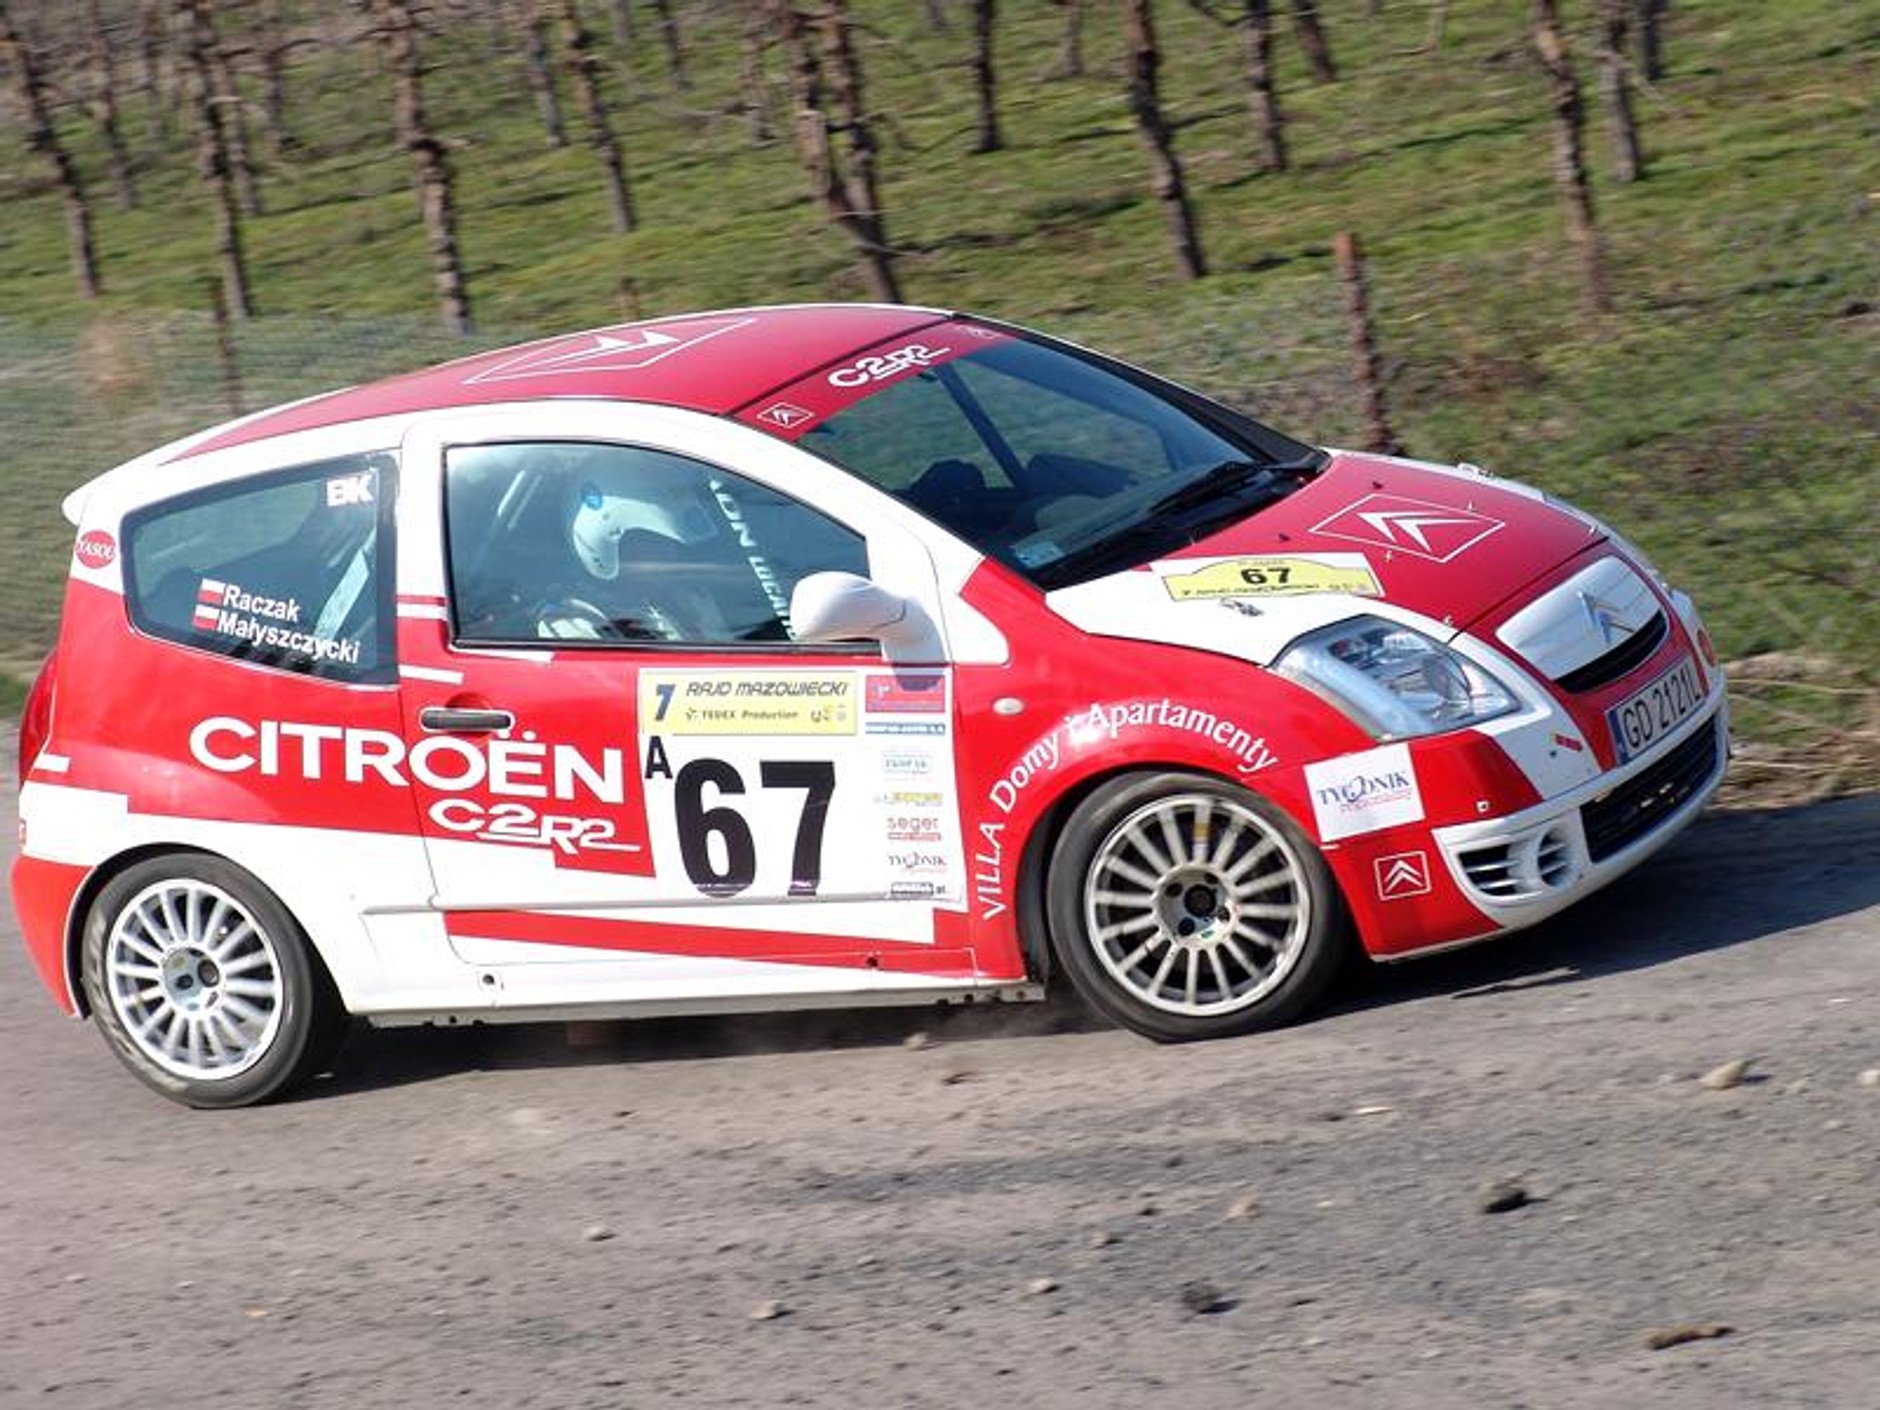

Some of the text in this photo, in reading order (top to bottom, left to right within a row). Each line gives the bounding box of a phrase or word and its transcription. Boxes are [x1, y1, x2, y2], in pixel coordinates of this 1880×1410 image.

[827, 344, 951, 388] C2R2
[1240, 567, 1291, 585] 67
[223, 584, 301, 622] Raczak
[217, 611, 361, 664] Małyszczycki
[655, 684, 677, 722] 7
[735, 680, 848, 697] MAZOWIECKI
[1088, 698, 1279, 773] Apartamenty
[1622, 699, 1654, 749] GD
[189, 716, 625, 804] CITROËN
[645, 736, 673, 779] A
[989, 732, 1063, 814] Domy
[428, 798, 641, 855] C2R2
[674, 757, 836, 898] 67
[976, 821, 1007, 921] VILLA
